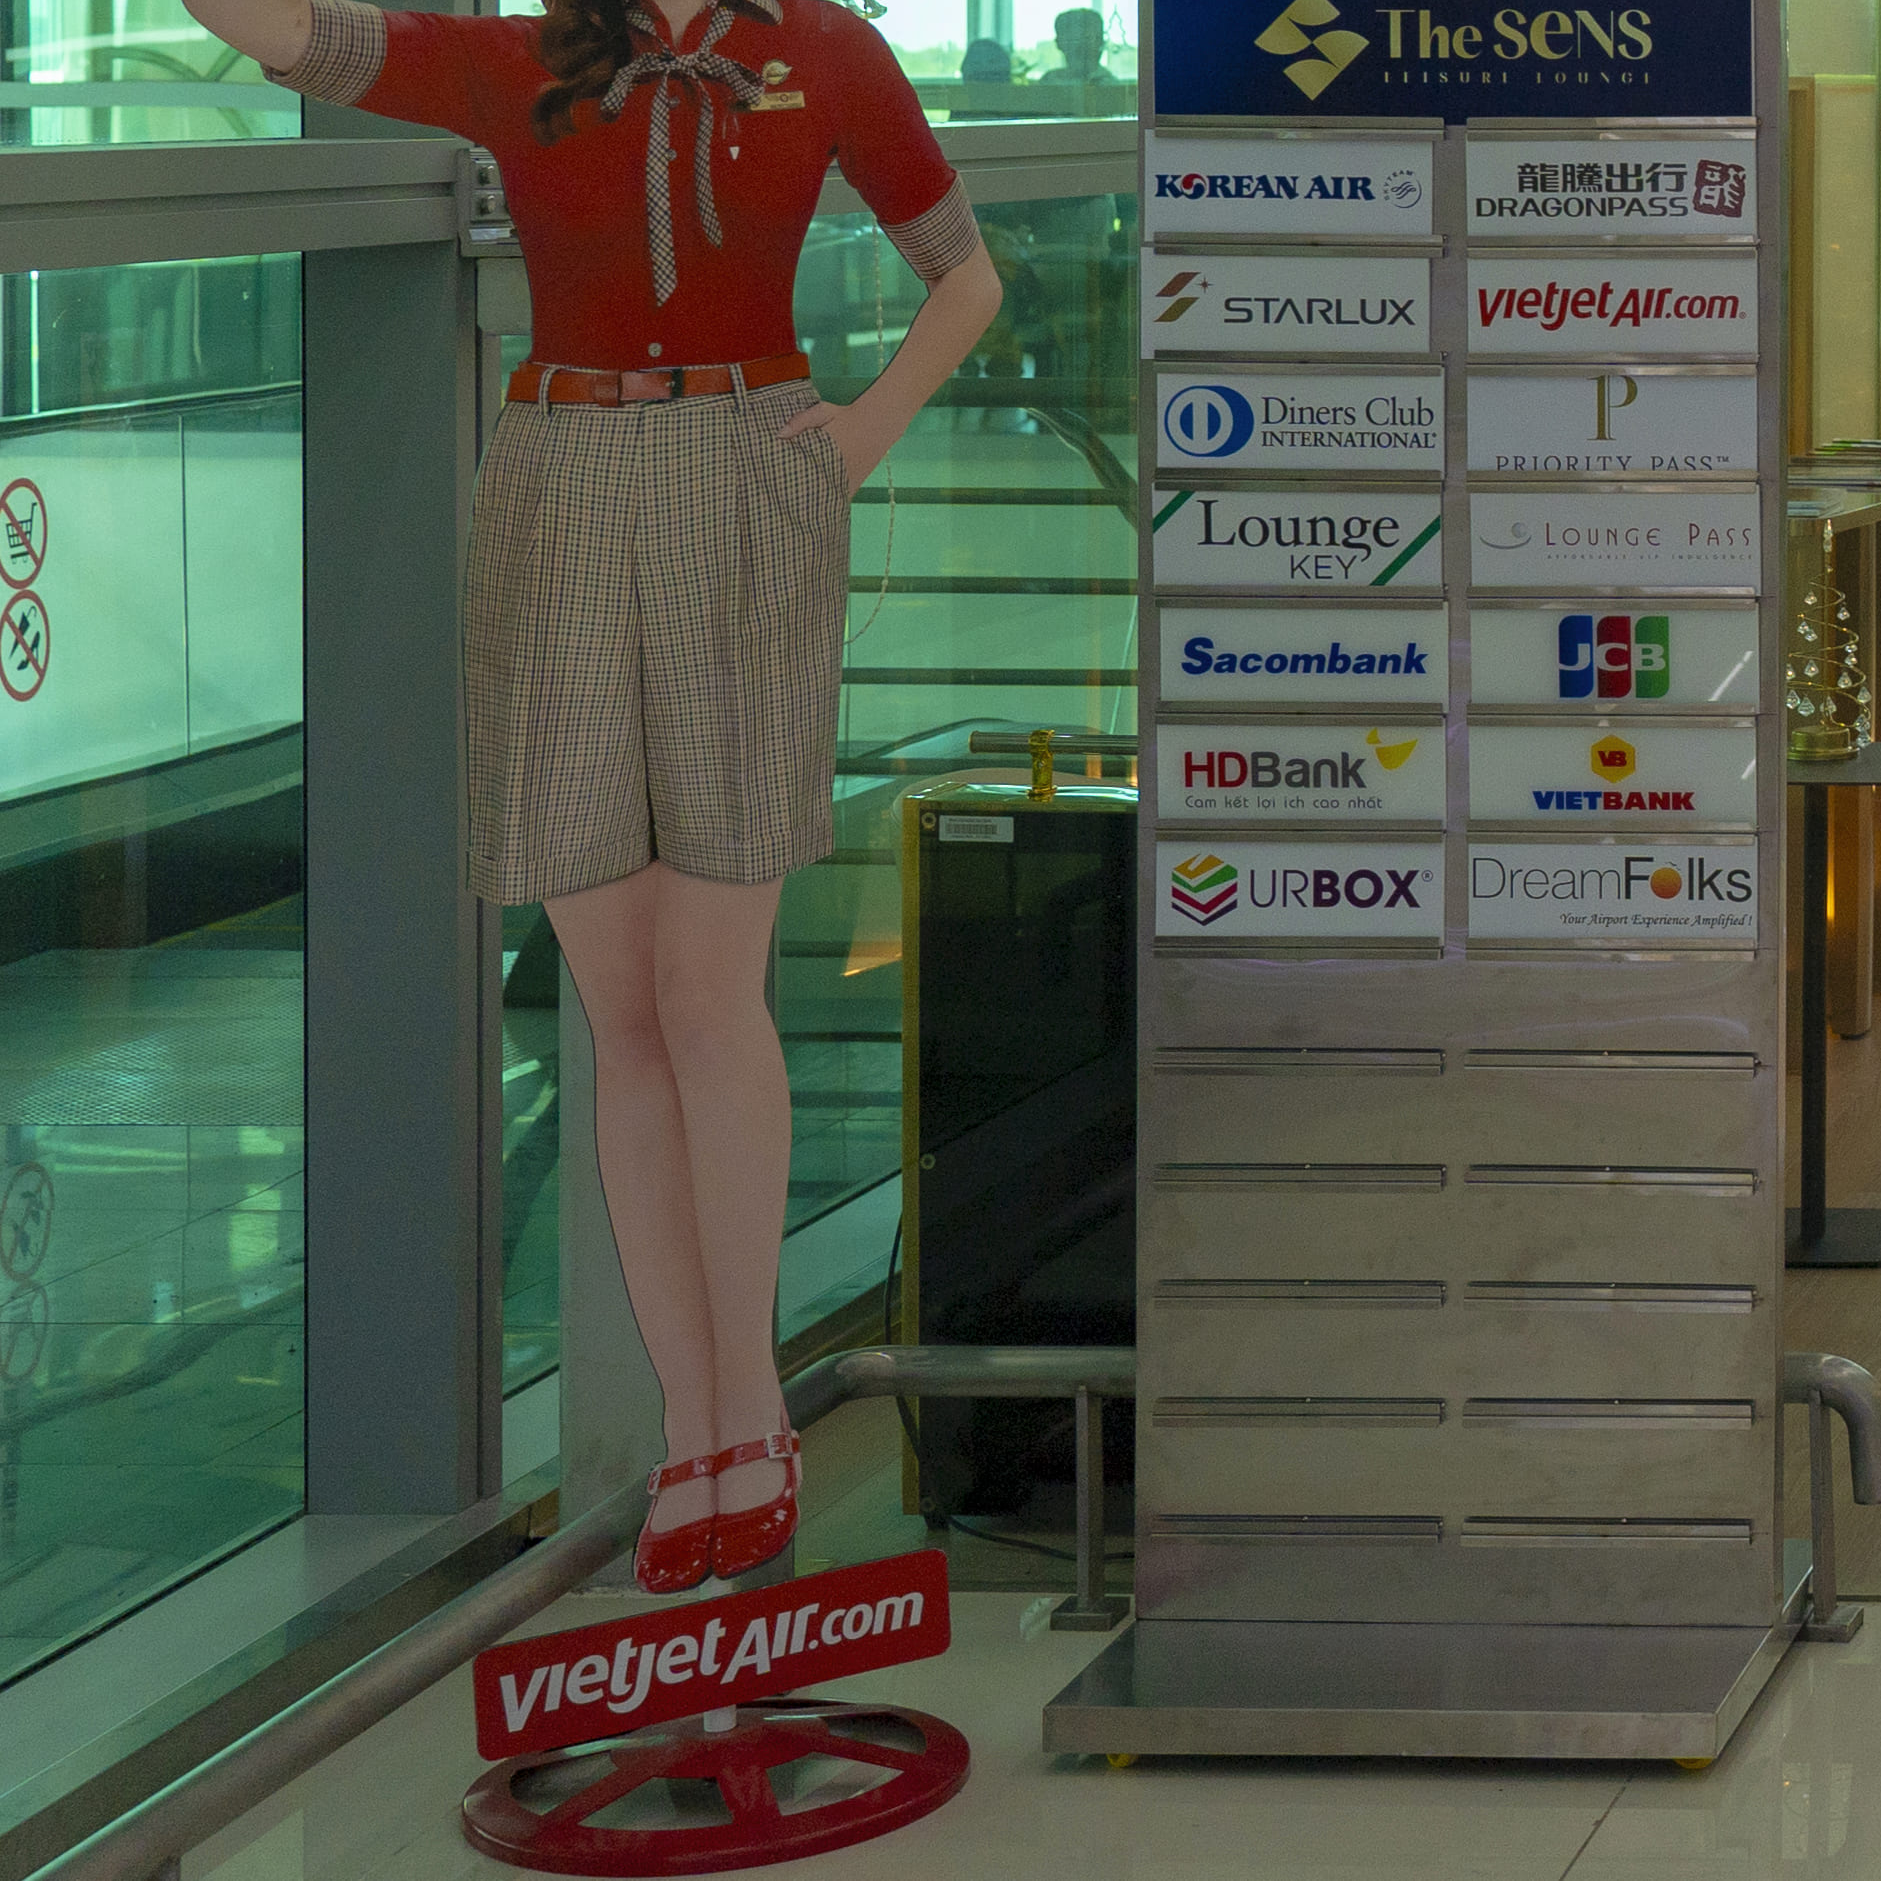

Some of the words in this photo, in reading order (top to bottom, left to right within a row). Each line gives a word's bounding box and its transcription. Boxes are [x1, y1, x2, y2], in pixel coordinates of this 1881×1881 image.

[1376, 10, 1482, 59] The
[1306, 175, 1375, 200] AIR
[1476, 197, 1688, 217] DRAGONPASS
[1224, 298, 1415, 325] STARLUX
[1262, 397, 1356, 425] Diners
[1365, 396, 1434, 426] Club
[1197, 500, 1399, 561] Lounge
[1291, 555, 1358, 579] KEY
[1182, 637, 1427, 675] Sacombank
[1185, 751, 1366, 788] HDBank
[1598, 750, 1627, 767] VB
[1185, 795, 1216, 808] Cam
[1313, 799, 1340, 809] cao
[1533, 791, 1694, 810] VIETBANK
[1560, 913, 1591, 926] Your
[1587, 914, 1628, 928] Airport
[1631, 914, 1693, 928] Experience
[1690, 914, 1747, 929] Amplified
